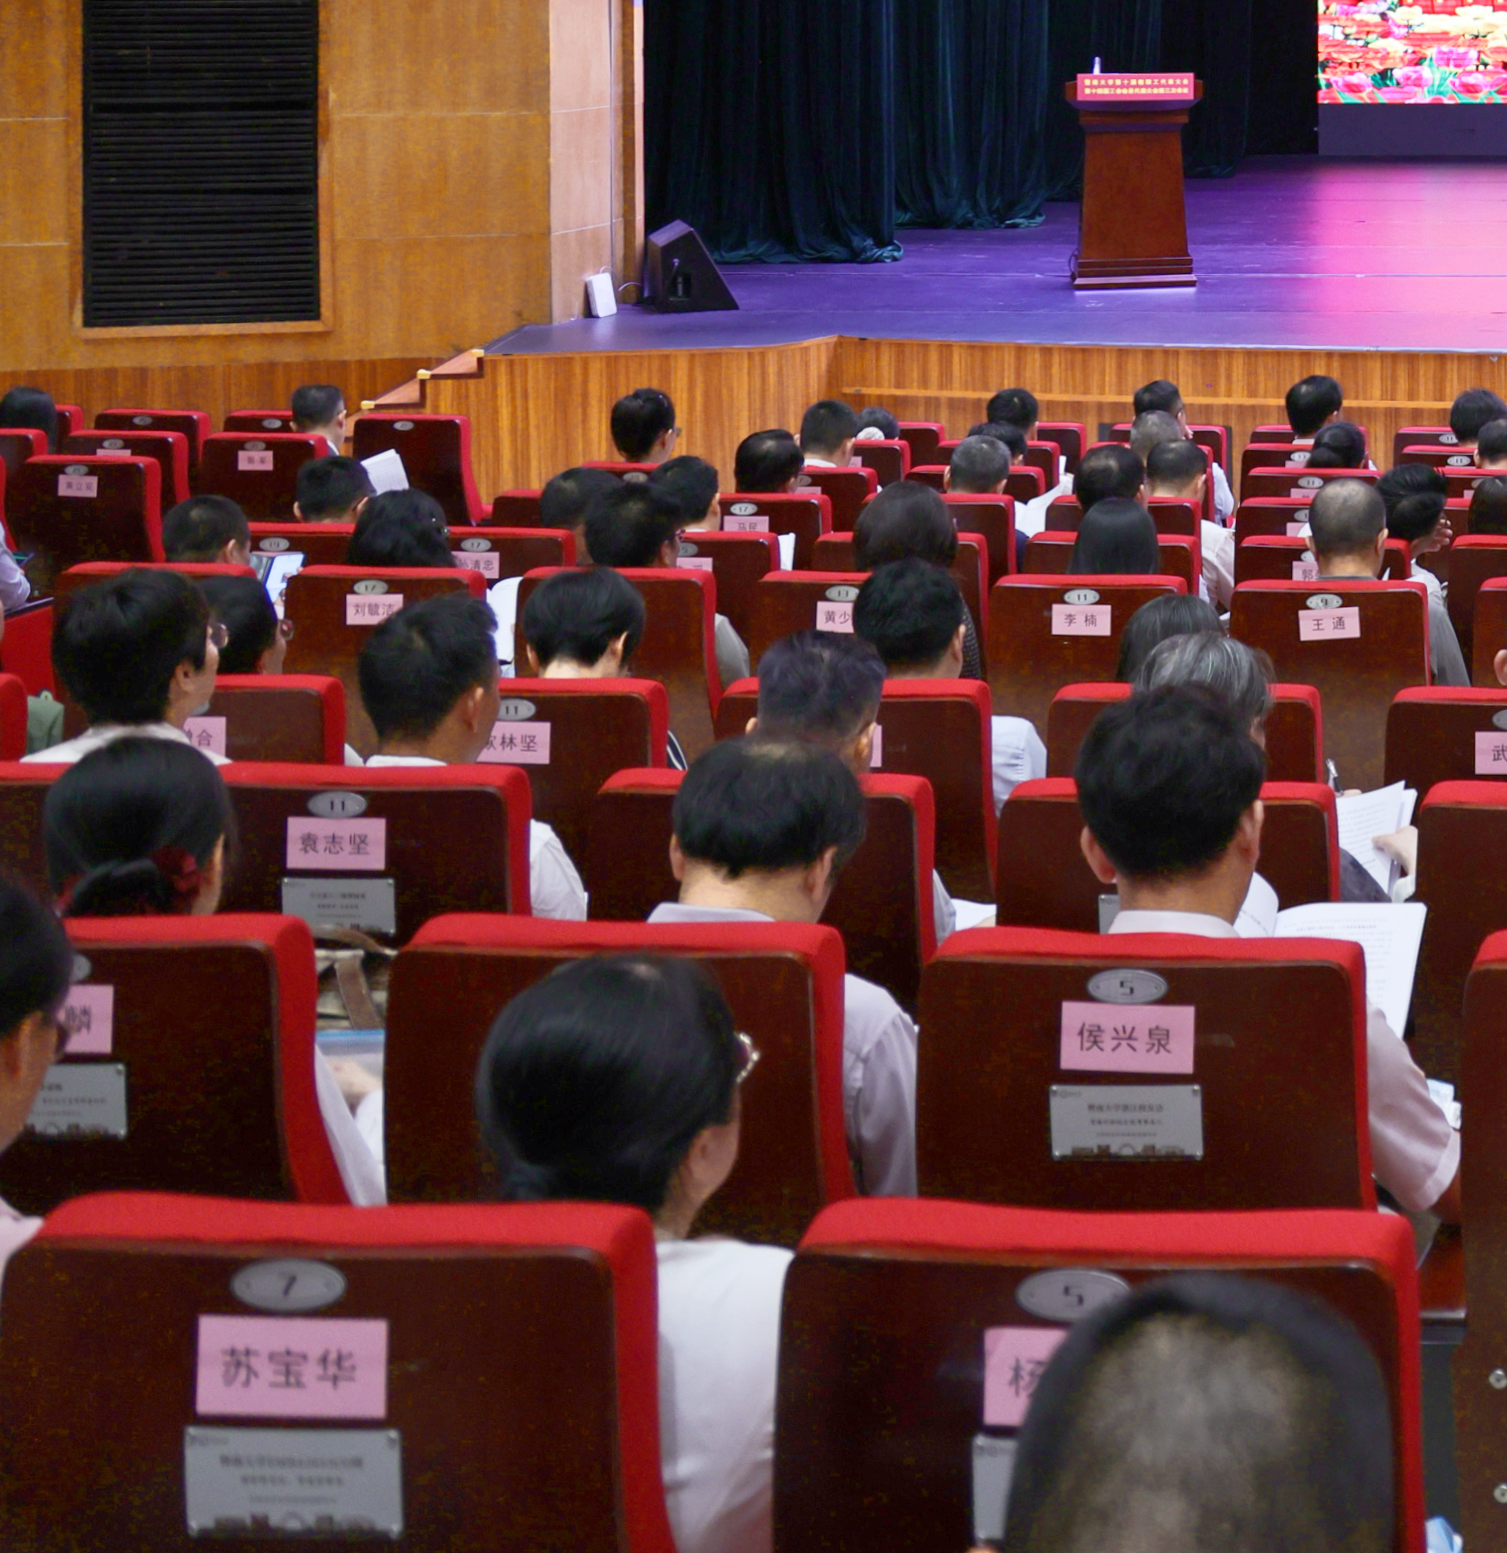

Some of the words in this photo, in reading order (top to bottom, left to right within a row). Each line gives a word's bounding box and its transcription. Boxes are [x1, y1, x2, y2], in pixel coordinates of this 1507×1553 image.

[823, 611, 855, 628] 黄少
[1065, 613, 1096, 626] 李楠
[1313, 616, 1345, 631] 王通
[505, 704, 519, 714] 11
[329, 798, 347, 811] 11
[300, 832, 368, 855] 袁志坚
[1120, 981, 1134, 995] 5
[1077, 1023, 1171, 1054] 侯兴泉
[283, 1276, 297, 1296] 7
[1063, 1285, 1085, 1307] 5
[223, 1347, 356, 1389] 苏宝华
